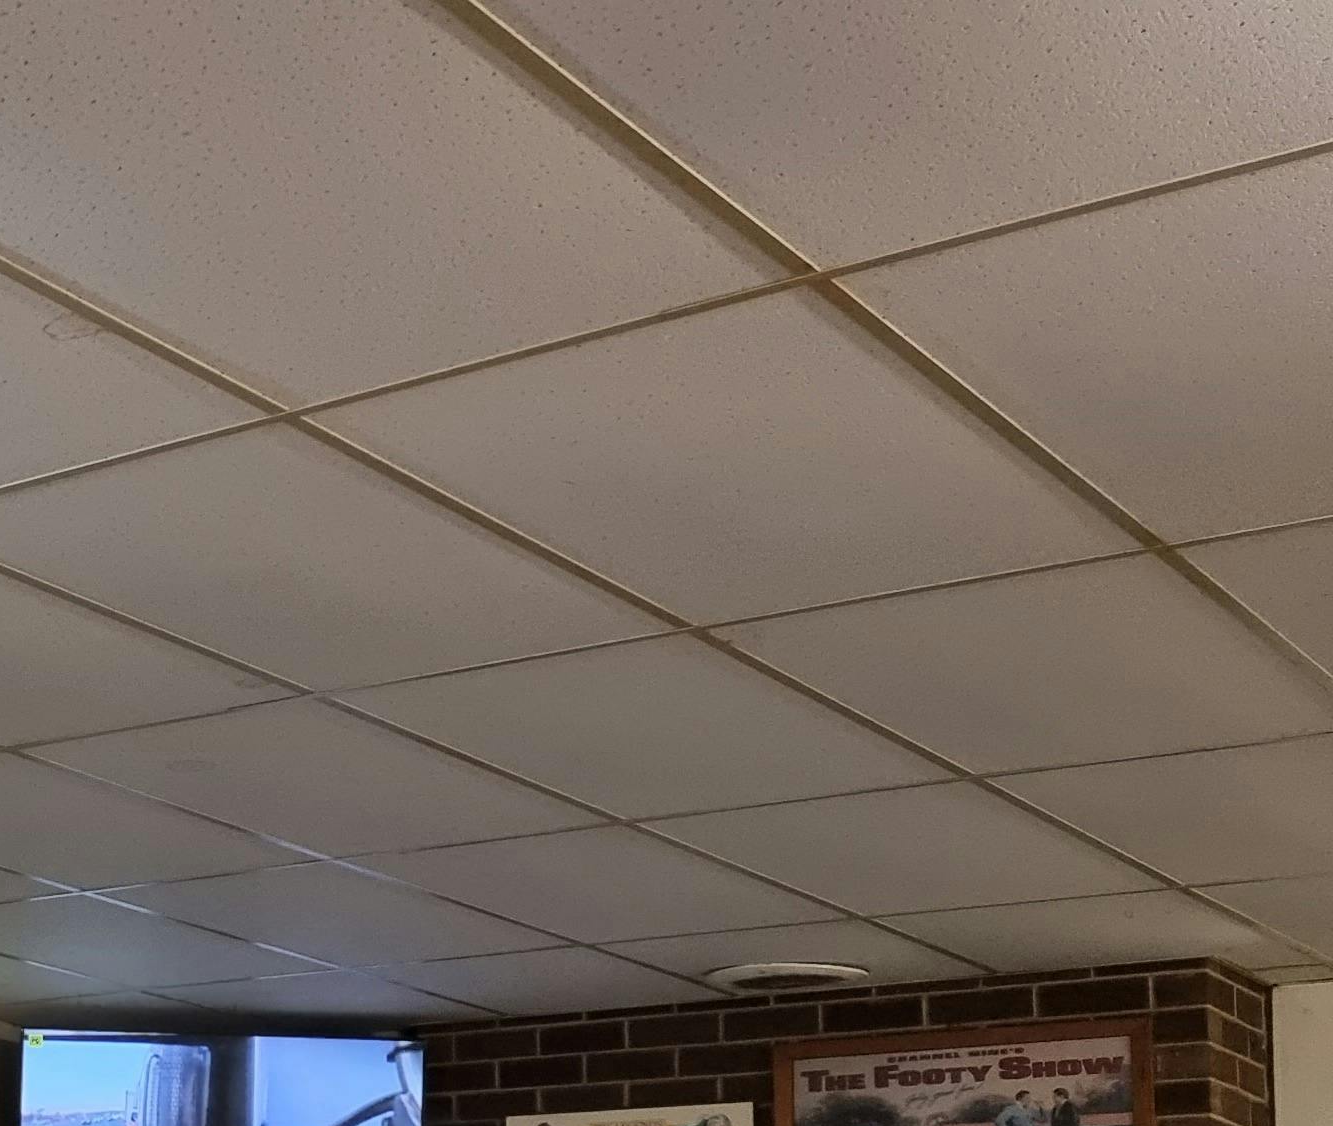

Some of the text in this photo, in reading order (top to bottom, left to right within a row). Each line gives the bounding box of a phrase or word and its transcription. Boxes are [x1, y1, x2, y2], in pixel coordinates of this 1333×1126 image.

[800, 1055, 1126, 1093] THE FOOTY SHOW
